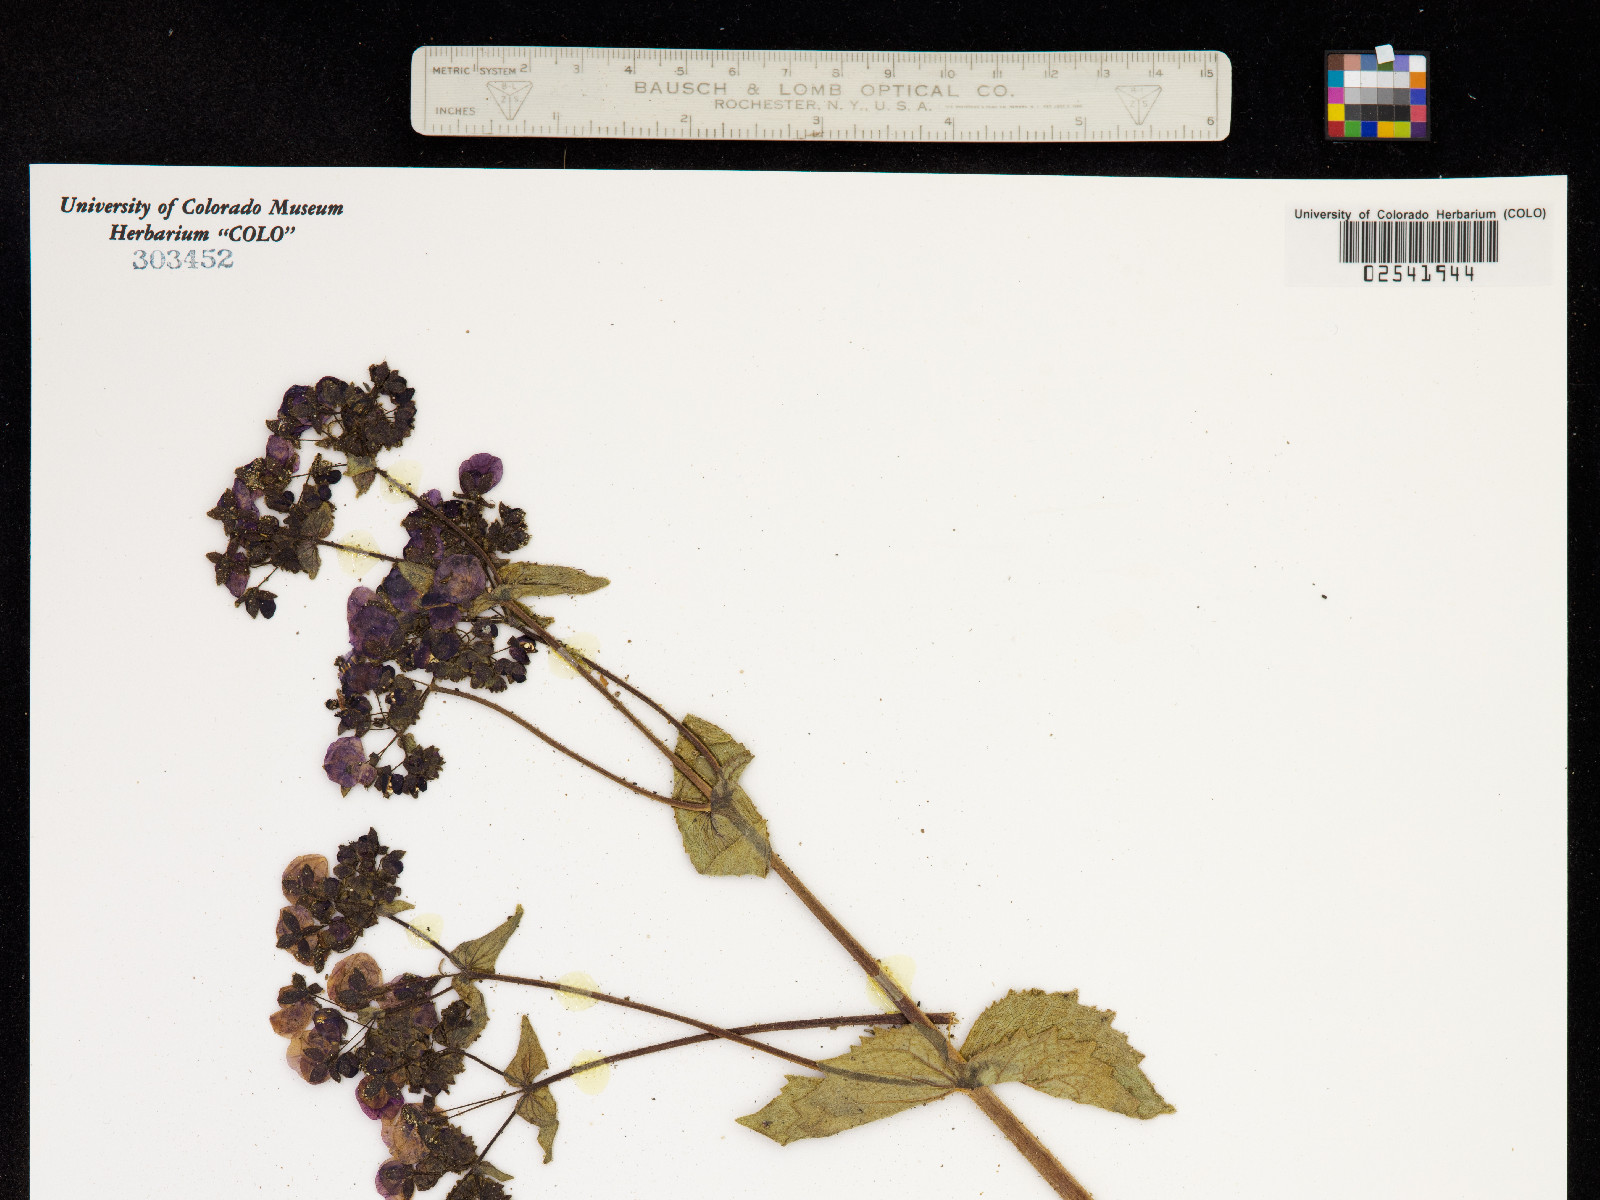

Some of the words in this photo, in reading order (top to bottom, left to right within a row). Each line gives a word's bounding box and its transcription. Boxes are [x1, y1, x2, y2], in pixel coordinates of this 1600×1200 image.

[432, 66, 471, 75] METRIC
[480, 67, 517, 76] SYSTEM
[520, 63, 528, 73] 2
[573, 65, 580, 74] 3
[624, 65, 633, 75] 4
[676, 67, 685, 76] 5
[728, 67, 737, 77] 6
[782, 68, 788, 77] 7
[884, 69, 892, 79] 9
[940, 70, 956, 79] 10
[1045, 70, 1059, 79] 12
[1097, 69, 1111, 79] 13
[1149, 69, 1164, 78] 14
[1200, 69, 1214, 78] 15
[634, 81, 727, 95] BAUSCH
[747, 83, 760, 96] &
[779, 83, 842, 96] LOMB
[861, 84, 960, 98] OPTICAL
[977, 84, 1015, 98] CO.
[435, 106, 476, 116] INCHES
[917, 102, 932, 112] A.
[680, 114, 688, 123] 2
[813, 116, 820, 125] 3
[944, 117, 953, 126] 4
[1075, 117, 1083, 126] 5
[1207, 117, 1215, 126] 6
[60, 196, 151, 220] University
[158, 197, 179, 220] of
[182, 198, 262, 215] Colorado
[269, 199, 344, 216] Museum
[1294, 209, 1352, 222] University
[1358, 209, 1371, 219] of
[1377, 209, 1429, 220] Colorado
[1436, 209, 1497, 220] Herbarium
[1503, 207, 1547, 220] (COLO)
[109, 223, 210, 242] Herbarium
[132, 248, 234, 270] 303452
[1363, 264, 1474, 283] 02541944
